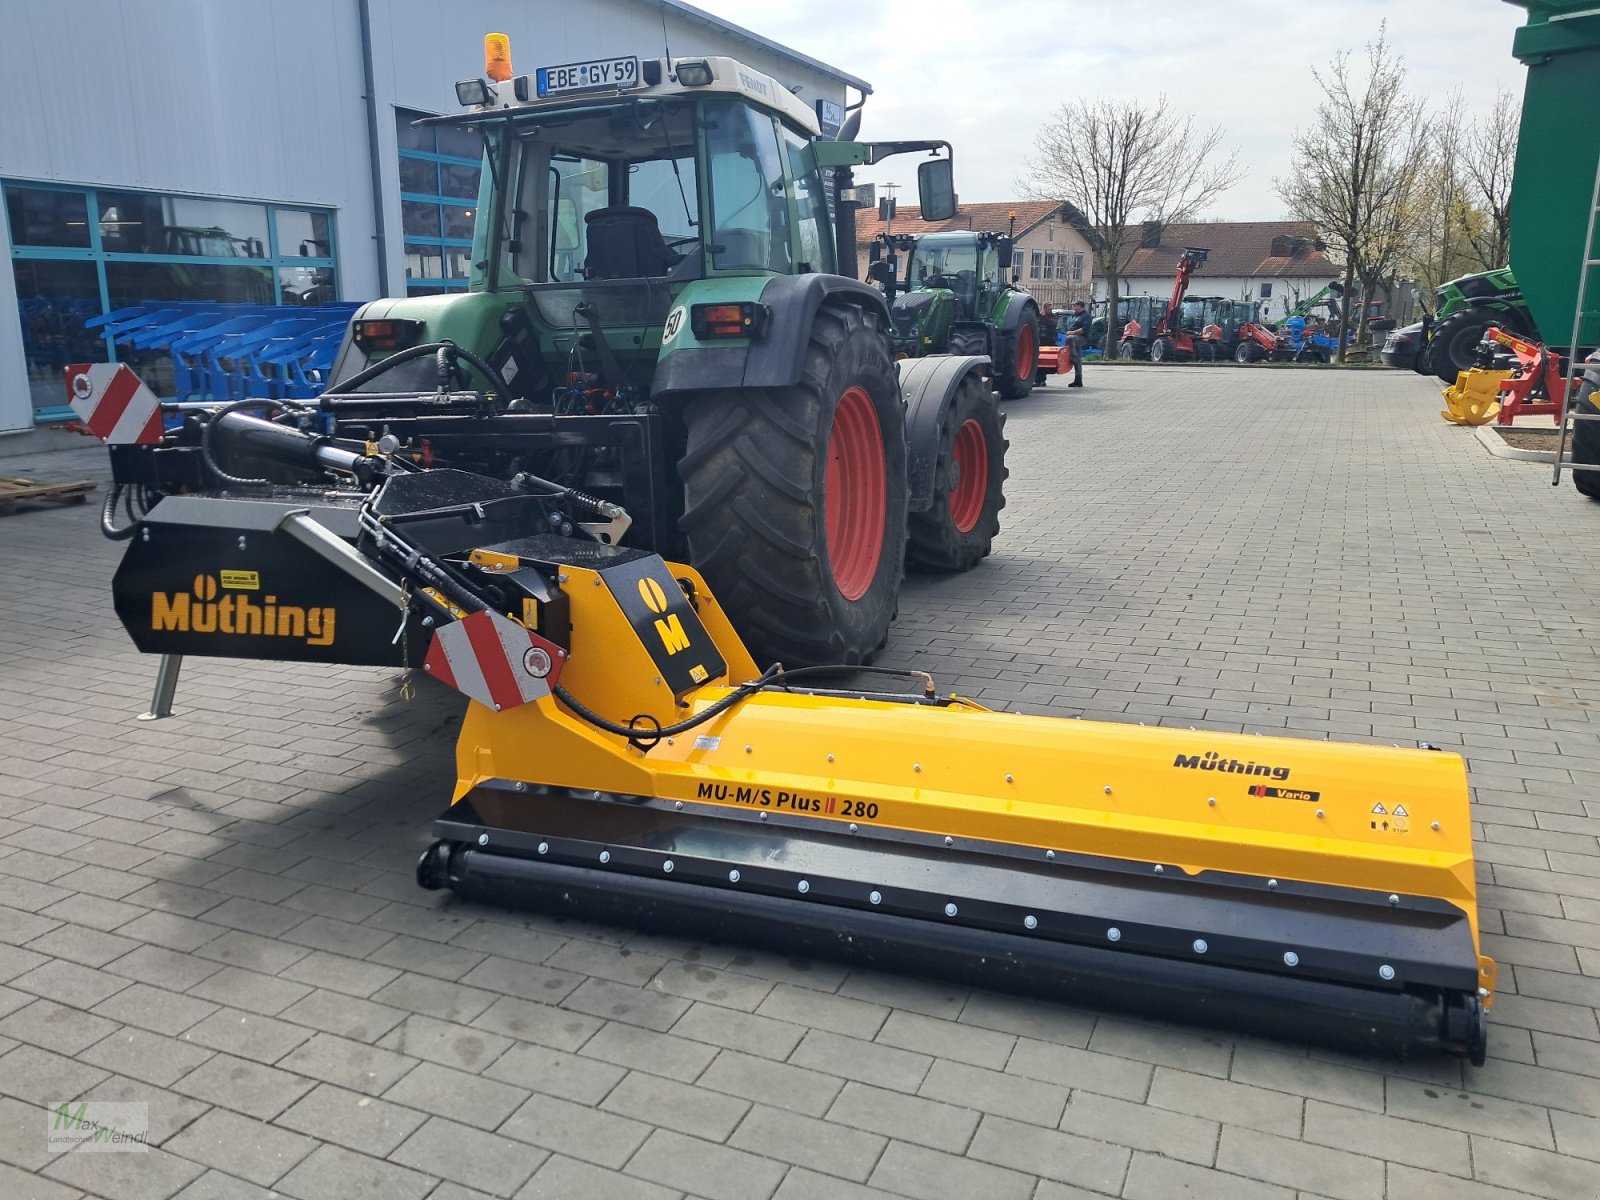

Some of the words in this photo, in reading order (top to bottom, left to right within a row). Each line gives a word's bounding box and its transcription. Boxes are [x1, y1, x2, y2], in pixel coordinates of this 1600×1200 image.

[547, 67, 579, 90] EBE
[589, 63, 611, 84] GY
[614, 60, 635, 81] 59
[664, 310, 682, 340] 50
[152, 573, 336, 646] Müthing
[1173, 751, 1290, 781] Müthing
[697, 782, 771, 806] MU-M/S
[776, 791, 821, 812] Plus
[841, 799, 879, 819] 280
[1277, 788, 1311, 801] Vario
